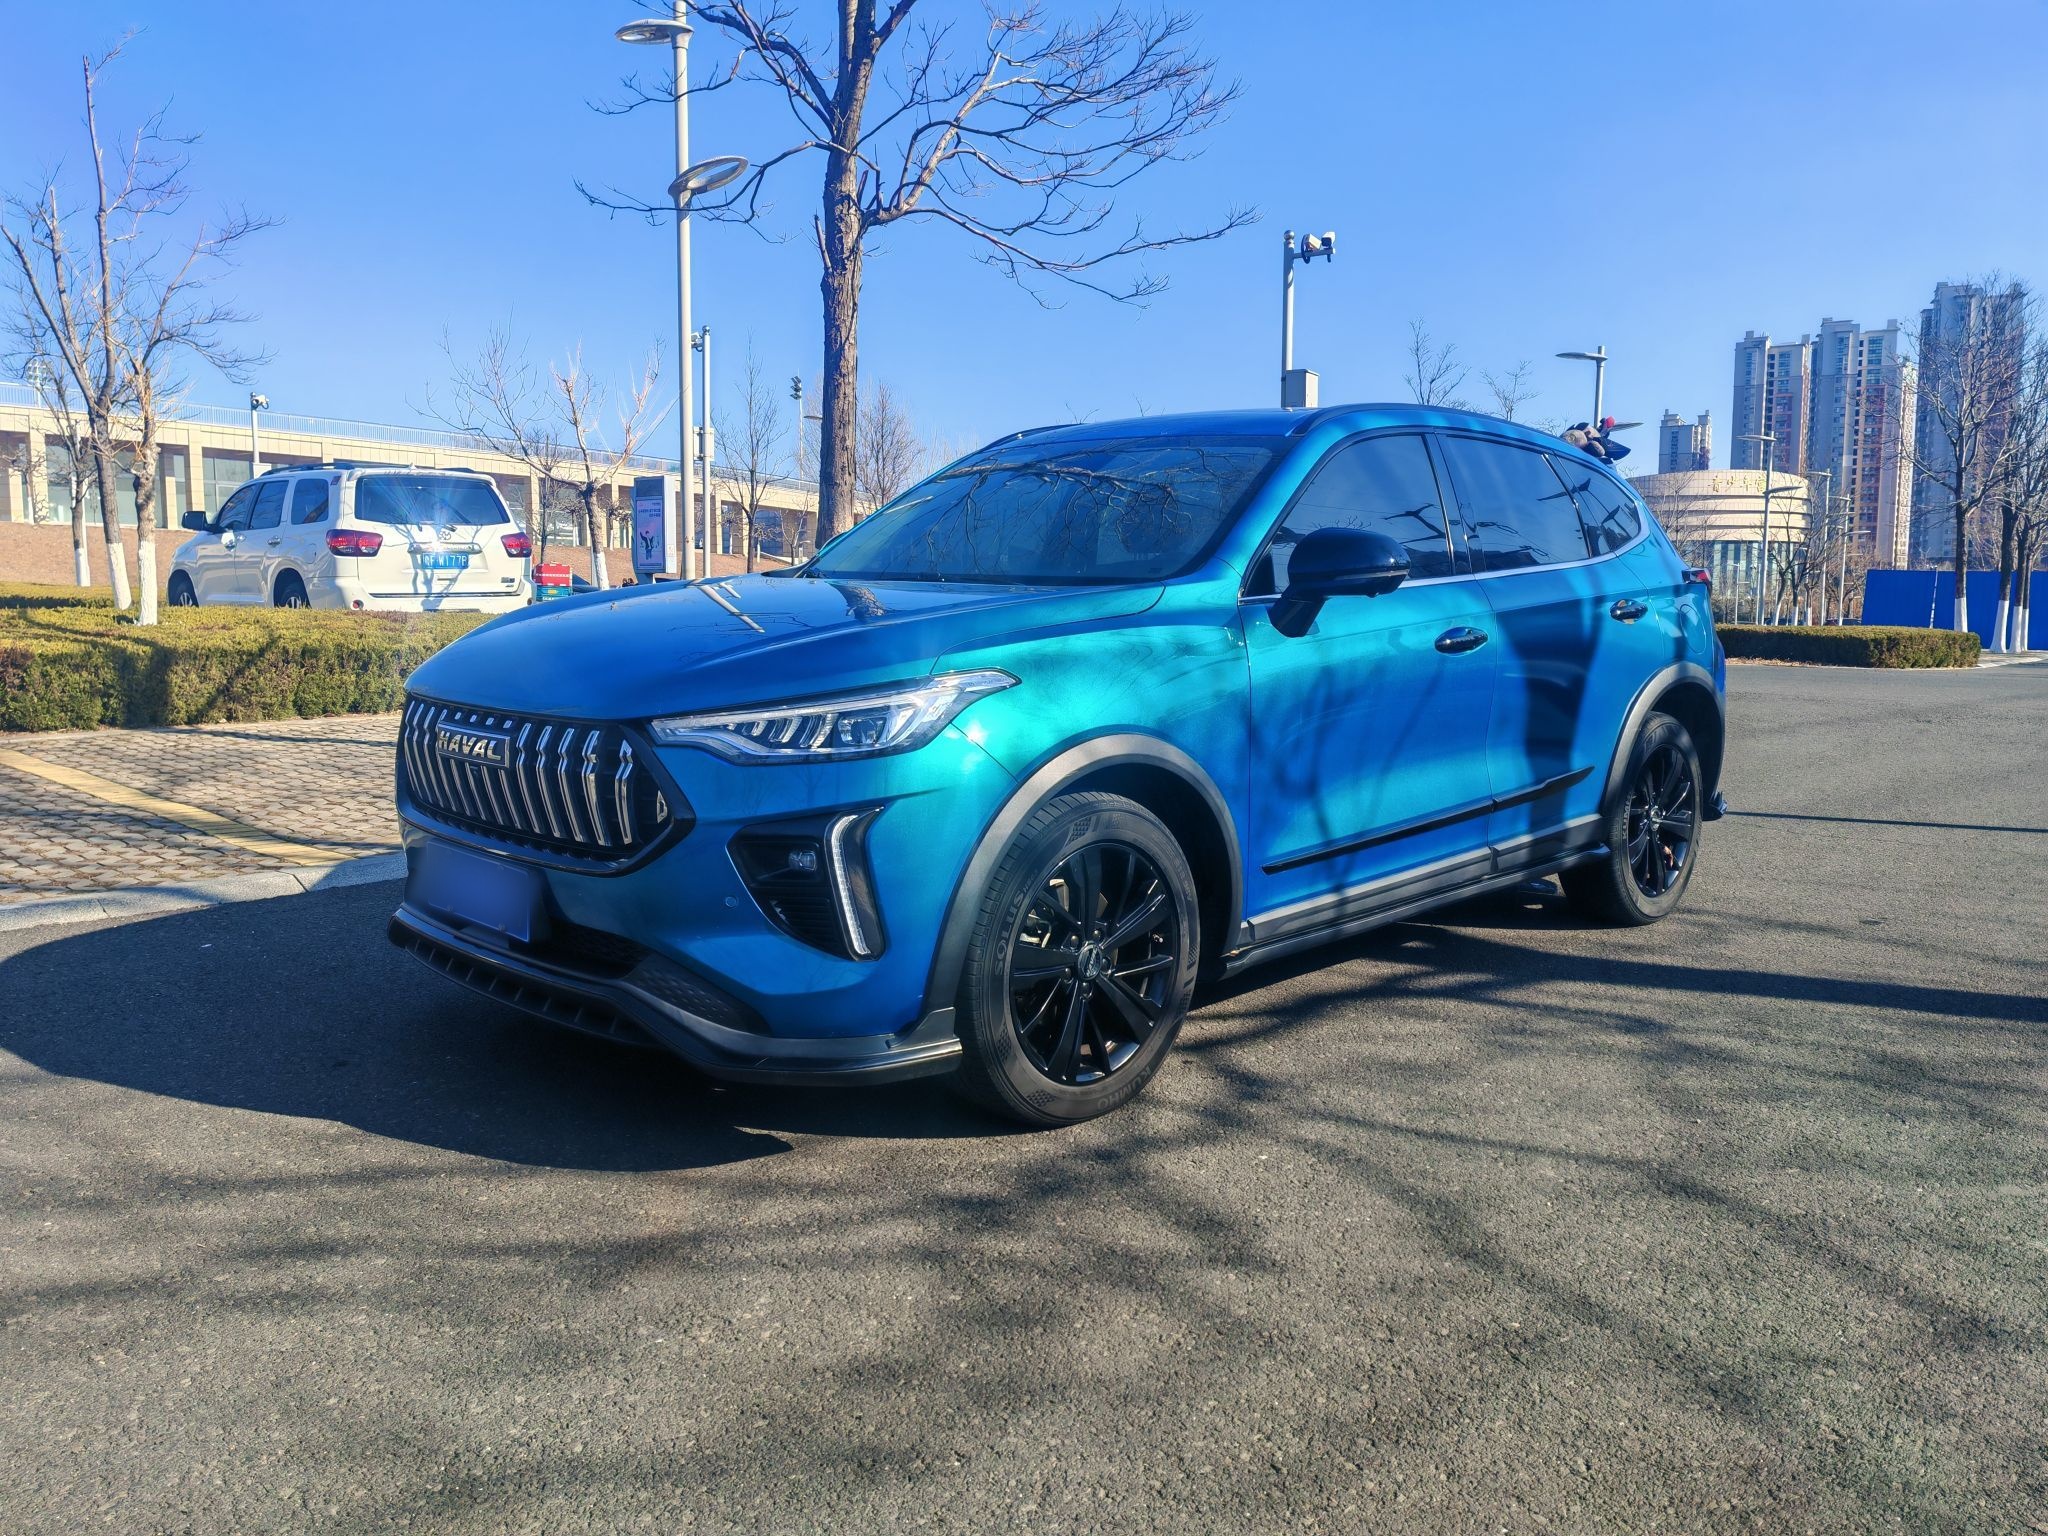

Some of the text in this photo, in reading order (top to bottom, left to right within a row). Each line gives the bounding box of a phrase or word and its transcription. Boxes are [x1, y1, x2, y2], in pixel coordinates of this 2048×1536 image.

[439, 730, 502, 761] HAVAL
[994, 889, 1025, 976] SOLUS
[1097, 1064, 1153, 1110] KUMHO
